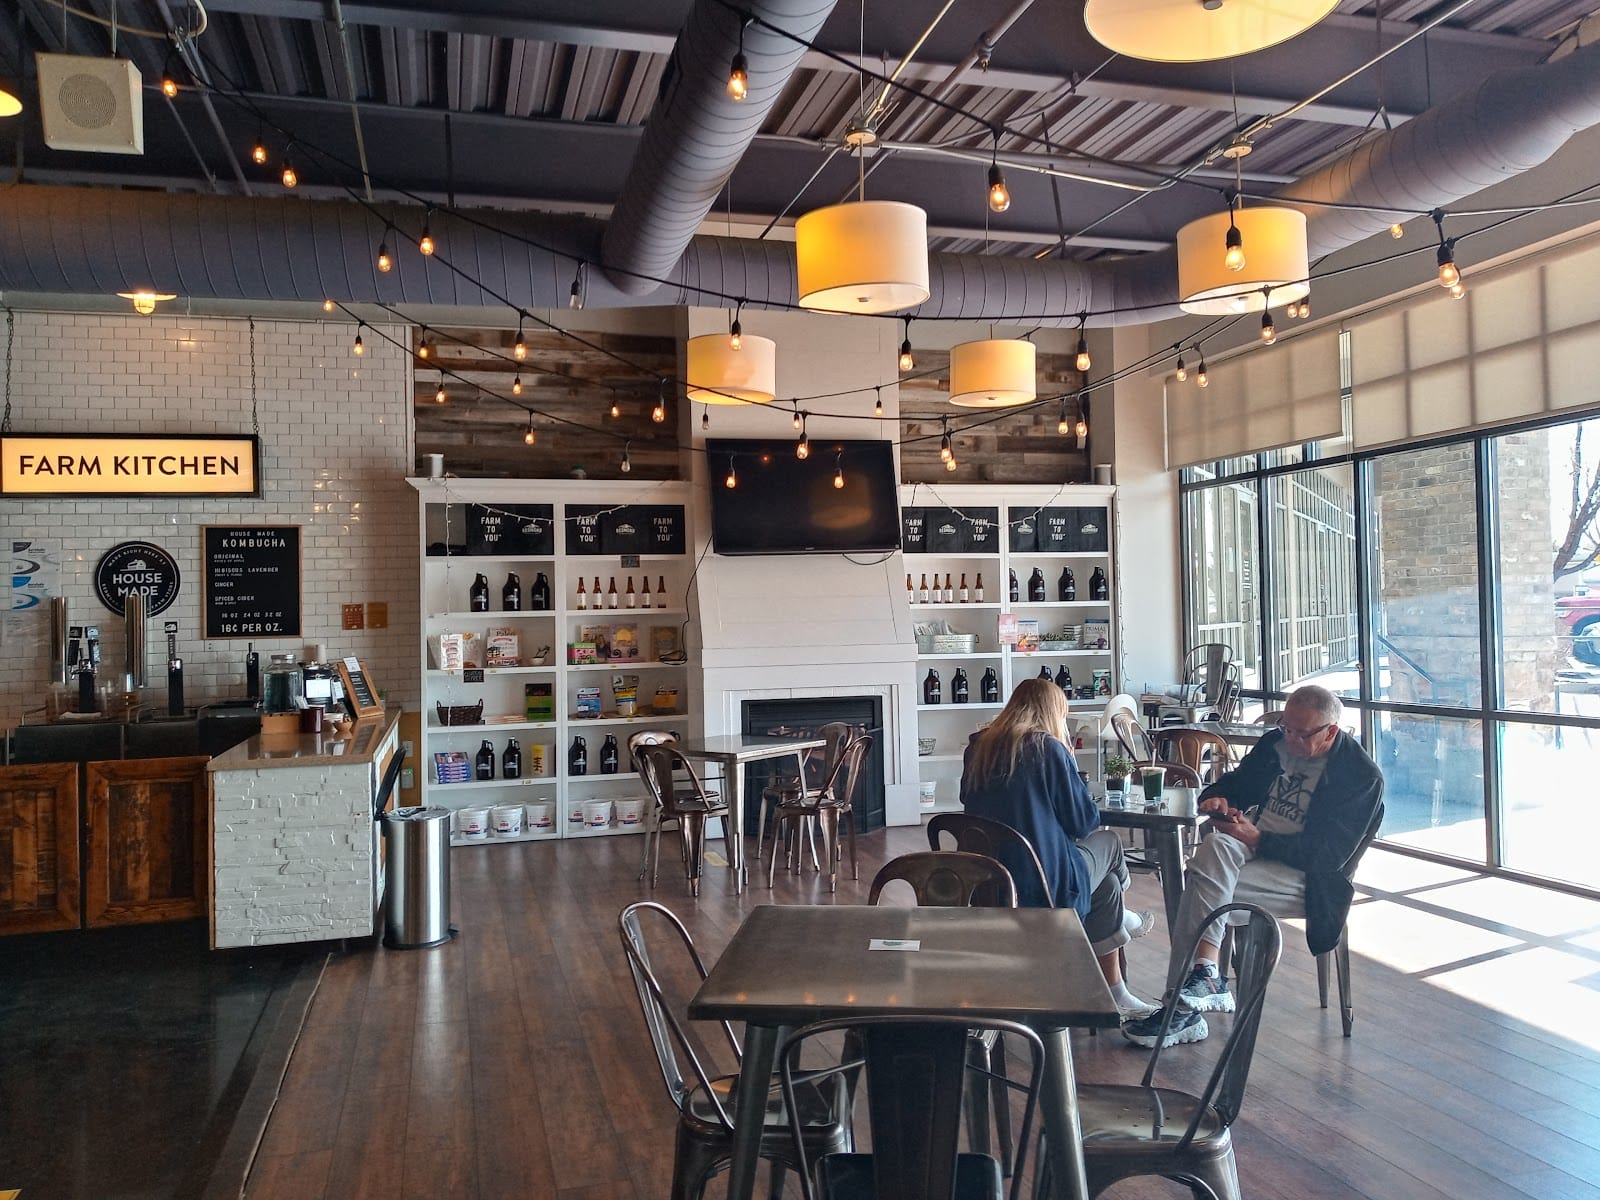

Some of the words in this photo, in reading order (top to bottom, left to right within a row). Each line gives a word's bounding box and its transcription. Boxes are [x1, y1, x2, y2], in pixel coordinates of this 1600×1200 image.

[20, 455, 102, 476] FARM
[114, 455, 239, 476] KITCHEN
[480, 516, 501, 525] FARM
[576, 517, 596, 526] FARM
[653, 517, 673, 525] FARM
[486, 525, 496, 534] TO
[581, 526, 591, 534] TO
[910, 526, 918, 534] TO
[975, 526, 983, 534] TO
[222, 538, 286, 548] KOMBUCHA
[112, 572, 163, 585] HOUSE
[117, 585, 159, 598] MADE
[221, 624, 238, 633] 16¢
[241, 623, 262, 633] PER
[265, 622, 283, 632] OZ.
